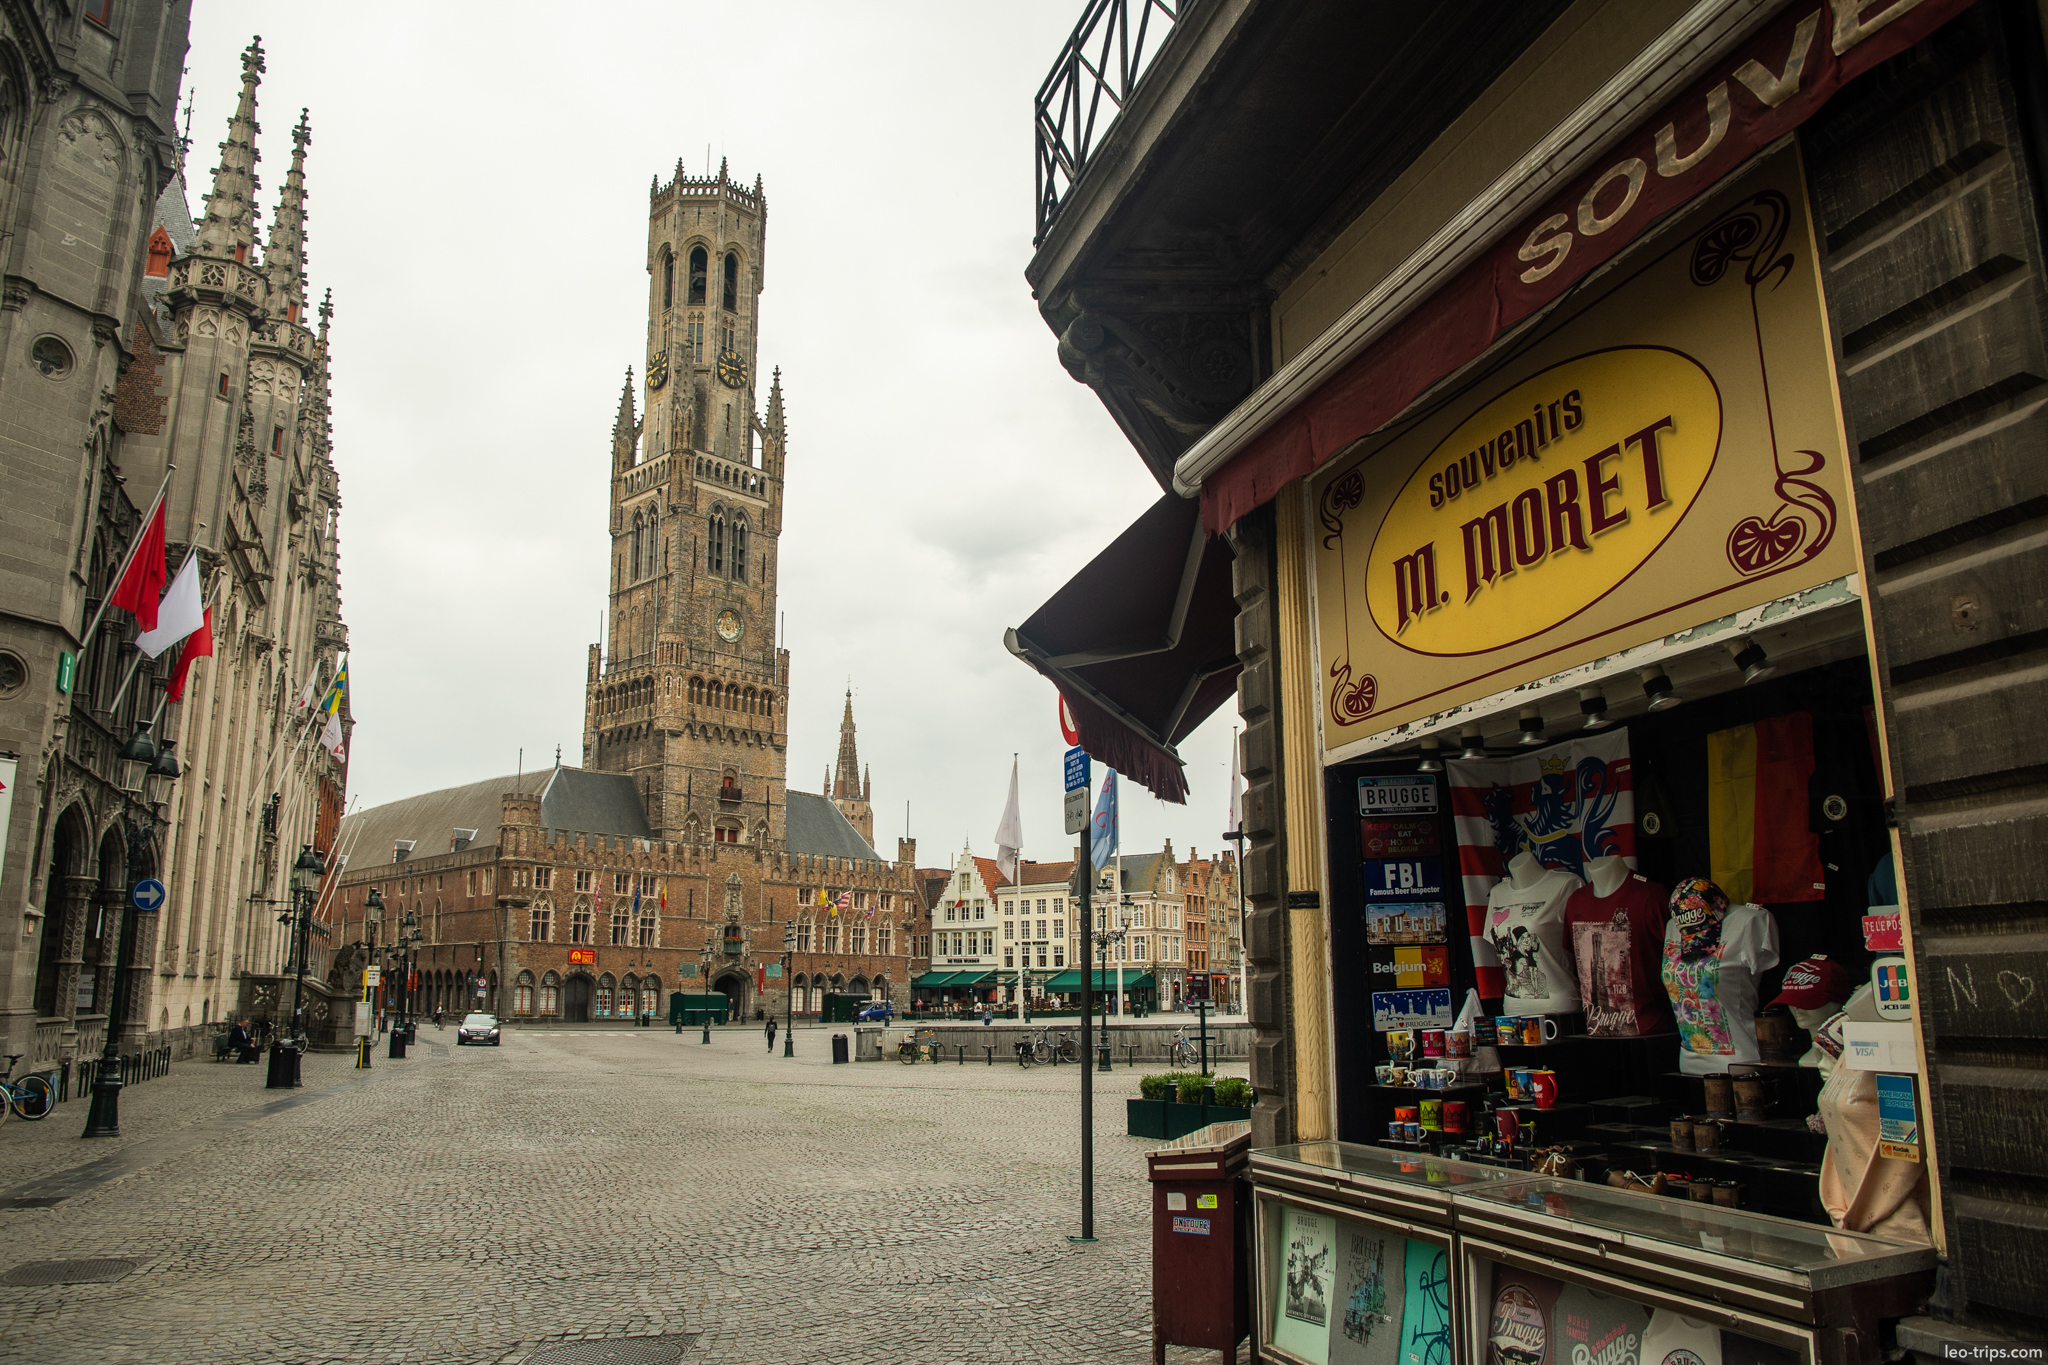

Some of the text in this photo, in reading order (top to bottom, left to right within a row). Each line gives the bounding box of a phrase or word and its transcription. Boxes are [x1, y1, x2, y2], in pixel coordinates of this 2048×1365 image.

[1459, 415, 1677, 604] MORET
[1366, 787, 1430, 805] BRUGGE
[1368, 823, 1391, 831] KEEP
[1388, 845, 1418, 853] BELGIUM
[1384, 862, 1423, 889] FBI
[1370, 886, 1440, 896] Famous Beer Inspector
[1370, 916, 1442, 933] BRUGGE
[1372, 961, 1427, 975] Belgium
[1880, 978, 1908, 988] JCB
[1582, 1001, 1635, 1036] Brugge
[1855, 1048, 1874, 1056] VISA
[1878, 1090, 1912, 1100] AMERICAN
[1886, 1099, 1915, 1110] EXPRESS
[1174, 1218, 1183, 1226] ON
[1494, 1298, 1544, 1348] Brugge
[1567, 1314, 1590, 1330] WORLD
[1566, 1326, 1588, 1342] FAMOUS
